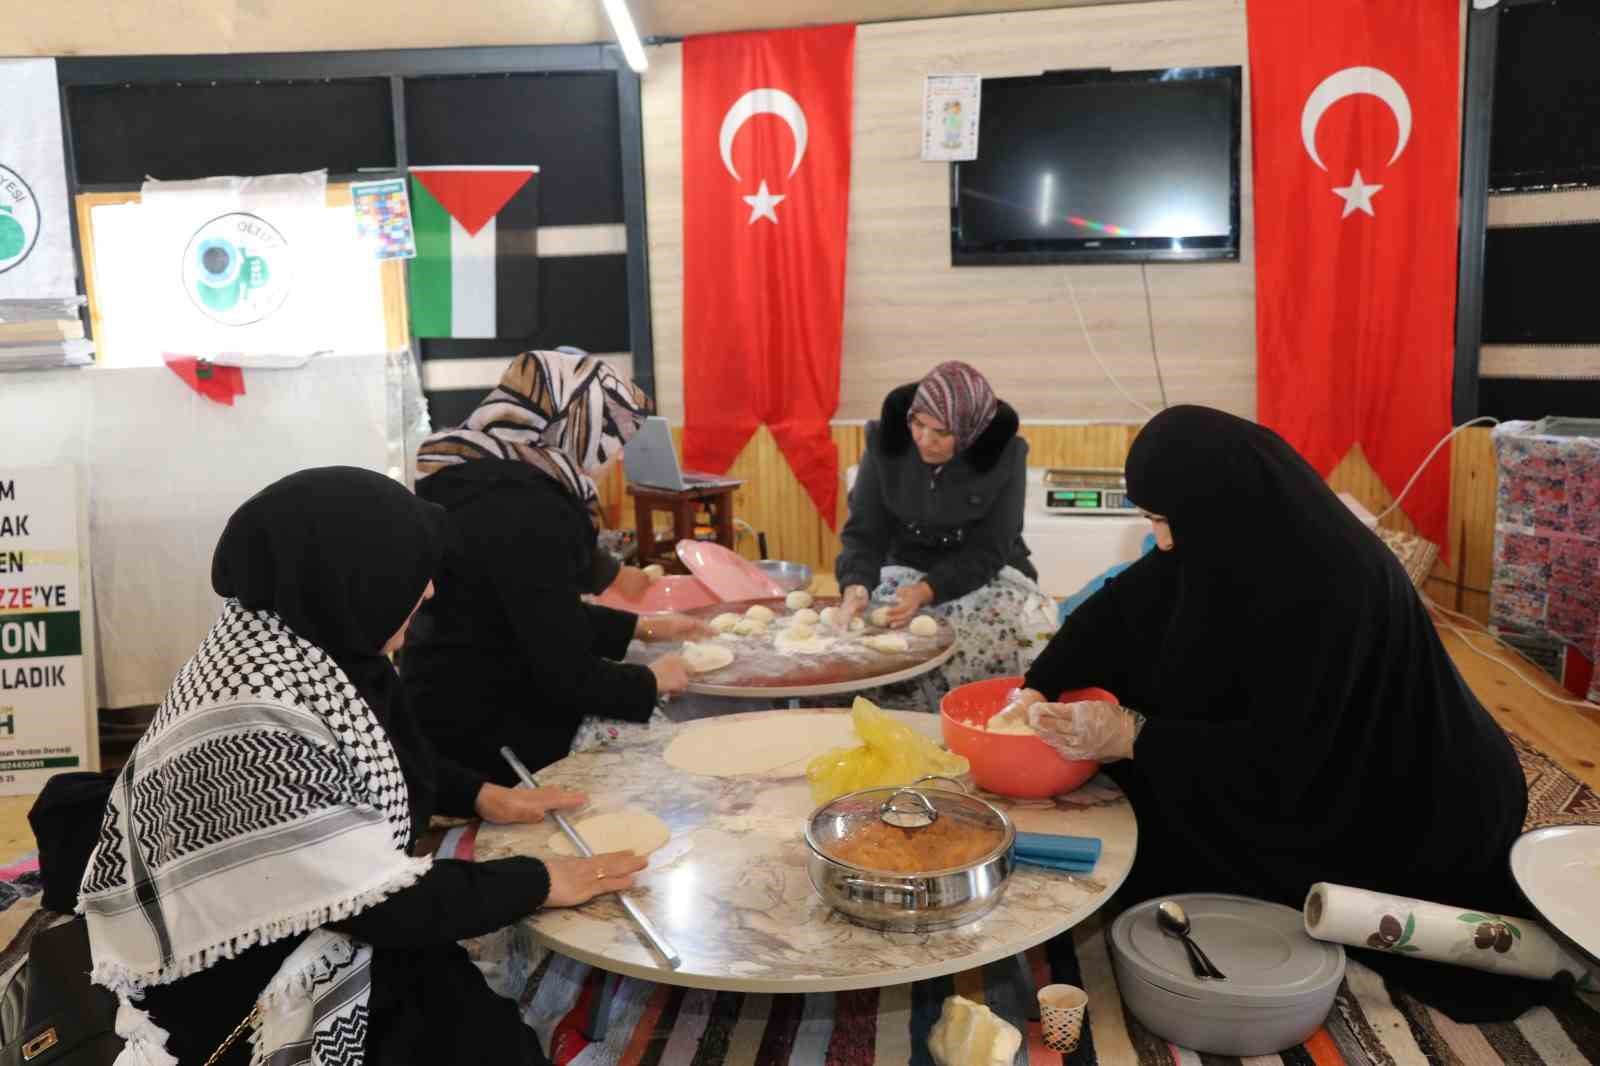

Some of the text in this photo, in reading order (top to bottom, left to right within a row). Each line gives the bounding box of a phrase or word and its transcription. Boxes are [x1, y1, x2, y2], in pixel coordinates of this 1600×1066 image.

[0, 514, 29, 537] AK
[0, 552, 24, 573] EN
[0, 620, 47, 654] ON
